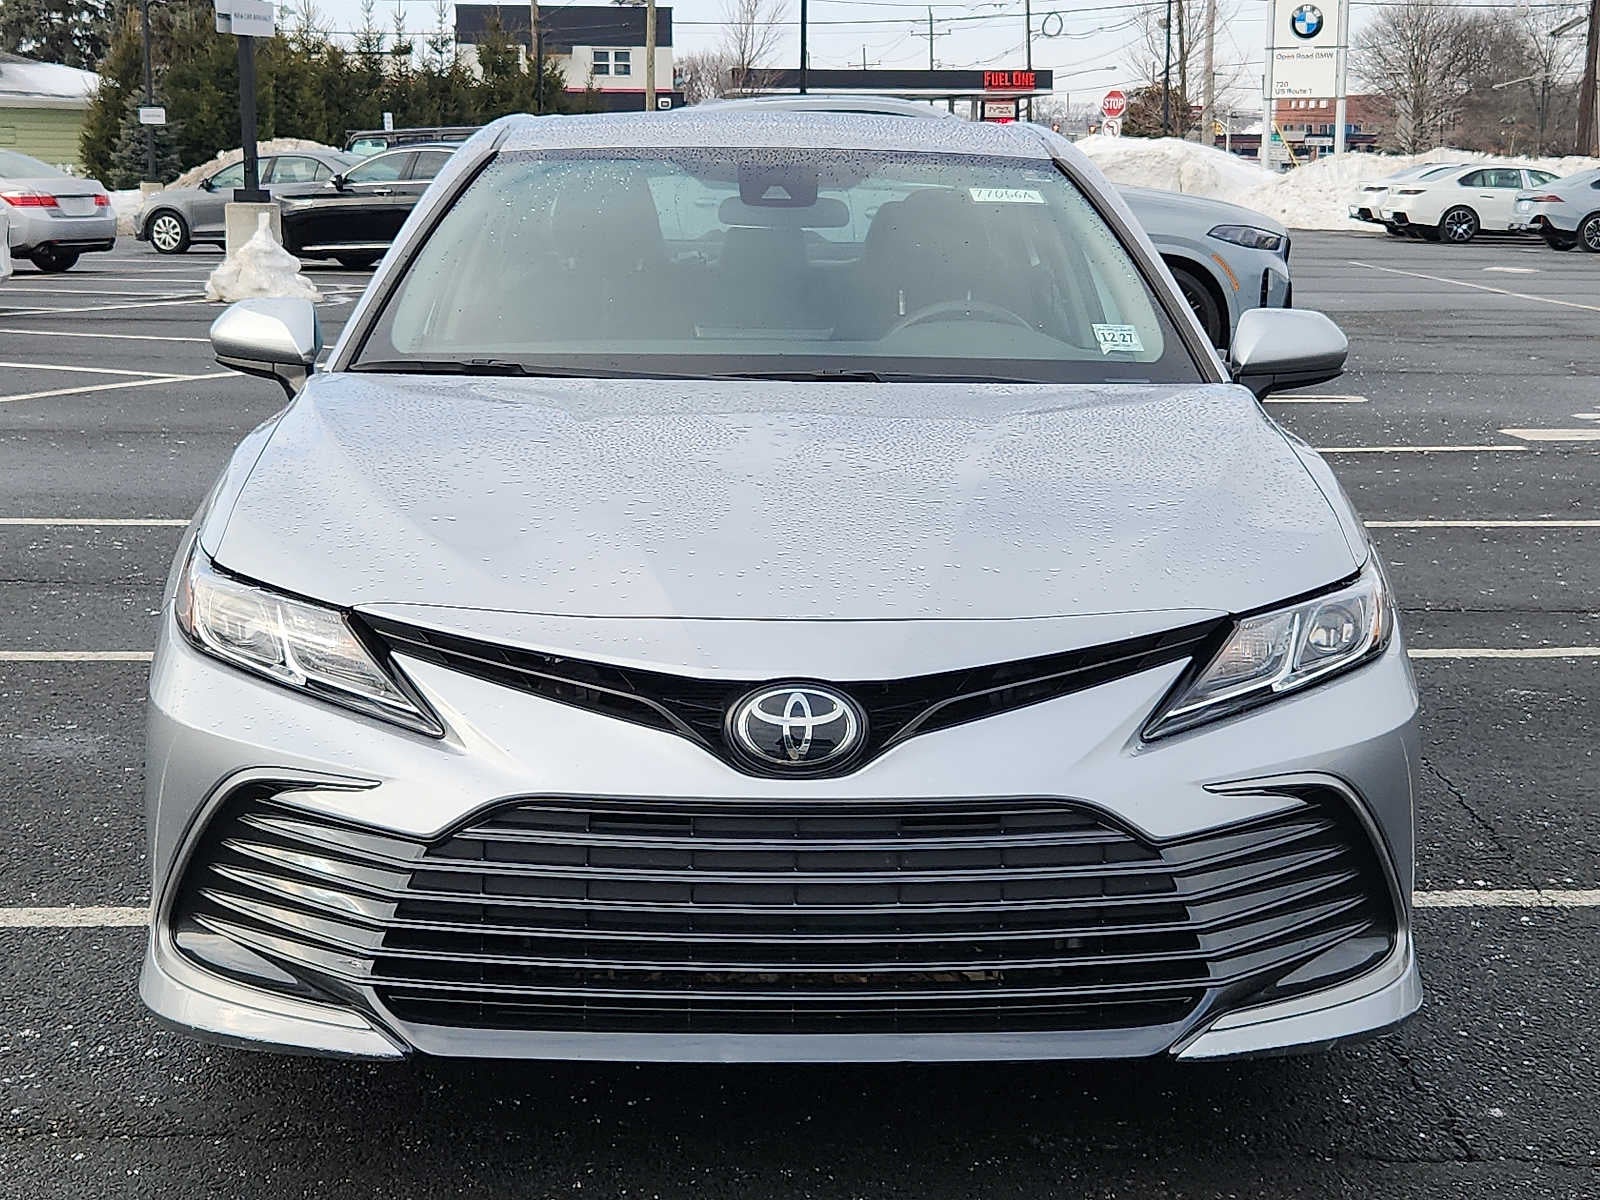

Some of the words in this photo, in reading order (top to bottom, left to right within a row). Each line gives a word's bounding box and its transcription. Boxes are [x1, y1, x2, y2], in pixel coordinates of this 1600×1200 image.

[1276, 53, 1295, 61] Open
[1296, 52, 1313, 60] Road
[1315, 52, 1334, 60] BMW
[984, 71, 1011, 86] FUEL
[1013, 70, 1035, 86] ONE
[1103, 97, 1124, 110] STOP
[1100, 332, 1118, 343] 12
[1119, 333, 1133, 343] 27
